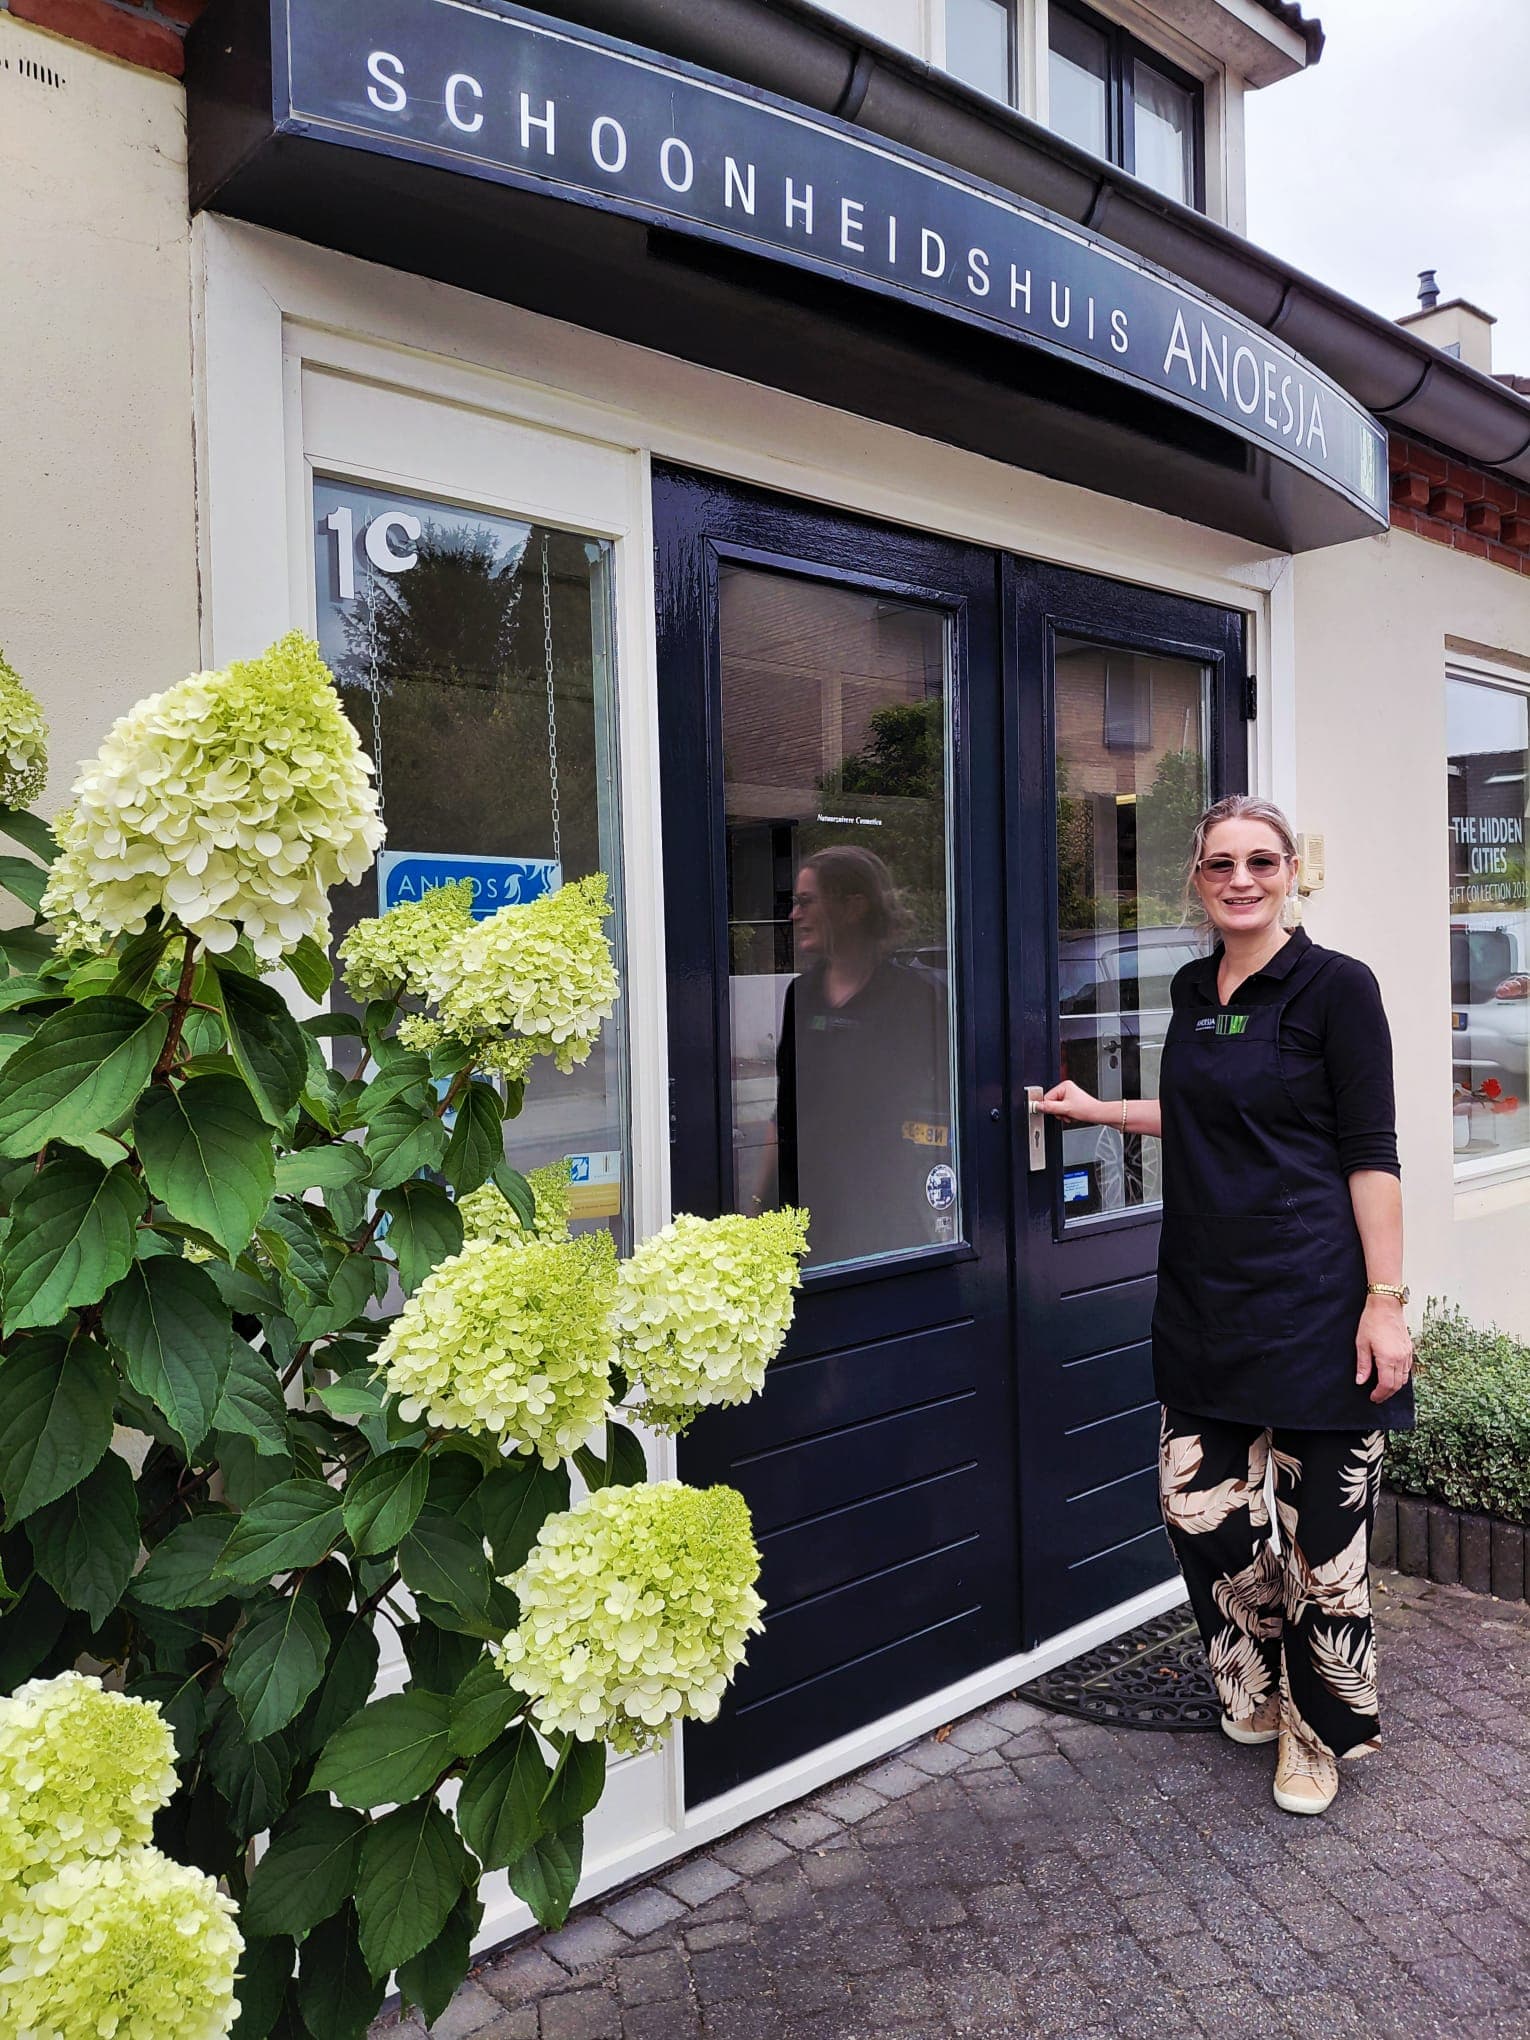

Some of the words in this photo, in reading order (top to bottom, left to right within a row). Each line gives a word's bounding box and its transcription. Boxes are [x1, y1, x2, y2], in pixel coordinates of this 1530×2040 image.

[366, 50, 1129, 354] SCHOONHEIDSHUIS
[1163, 306, 1328, 460] ANOESJA
[1451, 816, 1477, 845] THE
[1479, 817, 1523, 844] HIDDEN
[1471, 846, 1508, 874] CITIES
[1466, 882, 1511, 903] COLLECTION
